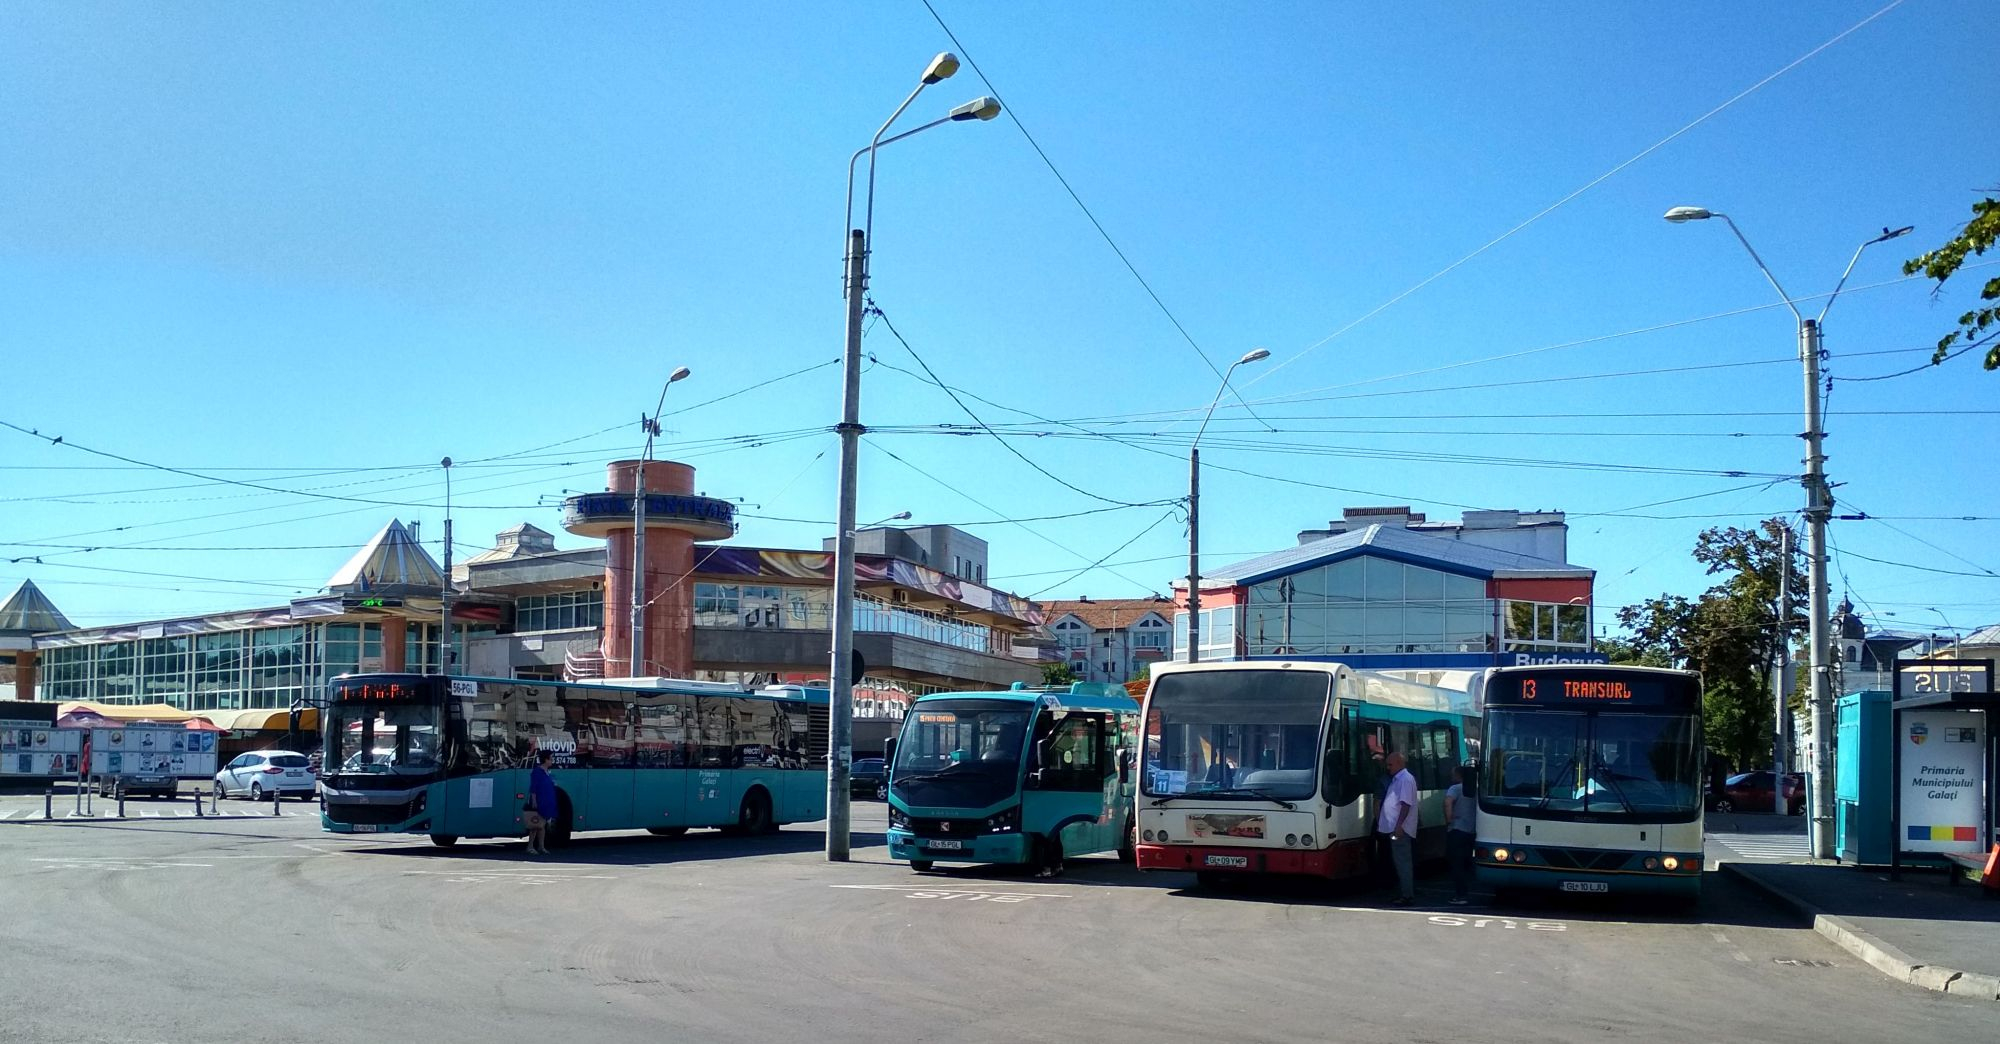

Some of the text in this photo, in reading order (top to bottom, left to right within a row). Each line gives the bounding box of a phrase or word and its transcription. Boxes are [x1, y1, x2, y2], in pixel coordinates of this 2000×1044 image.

[453, 682, 474, 695] 56-PGL
[1522, 679, 1536, 699] 13
[1157, 780, 1167, 791] 11
[1911, 778, 1974, 788] Municipiului
